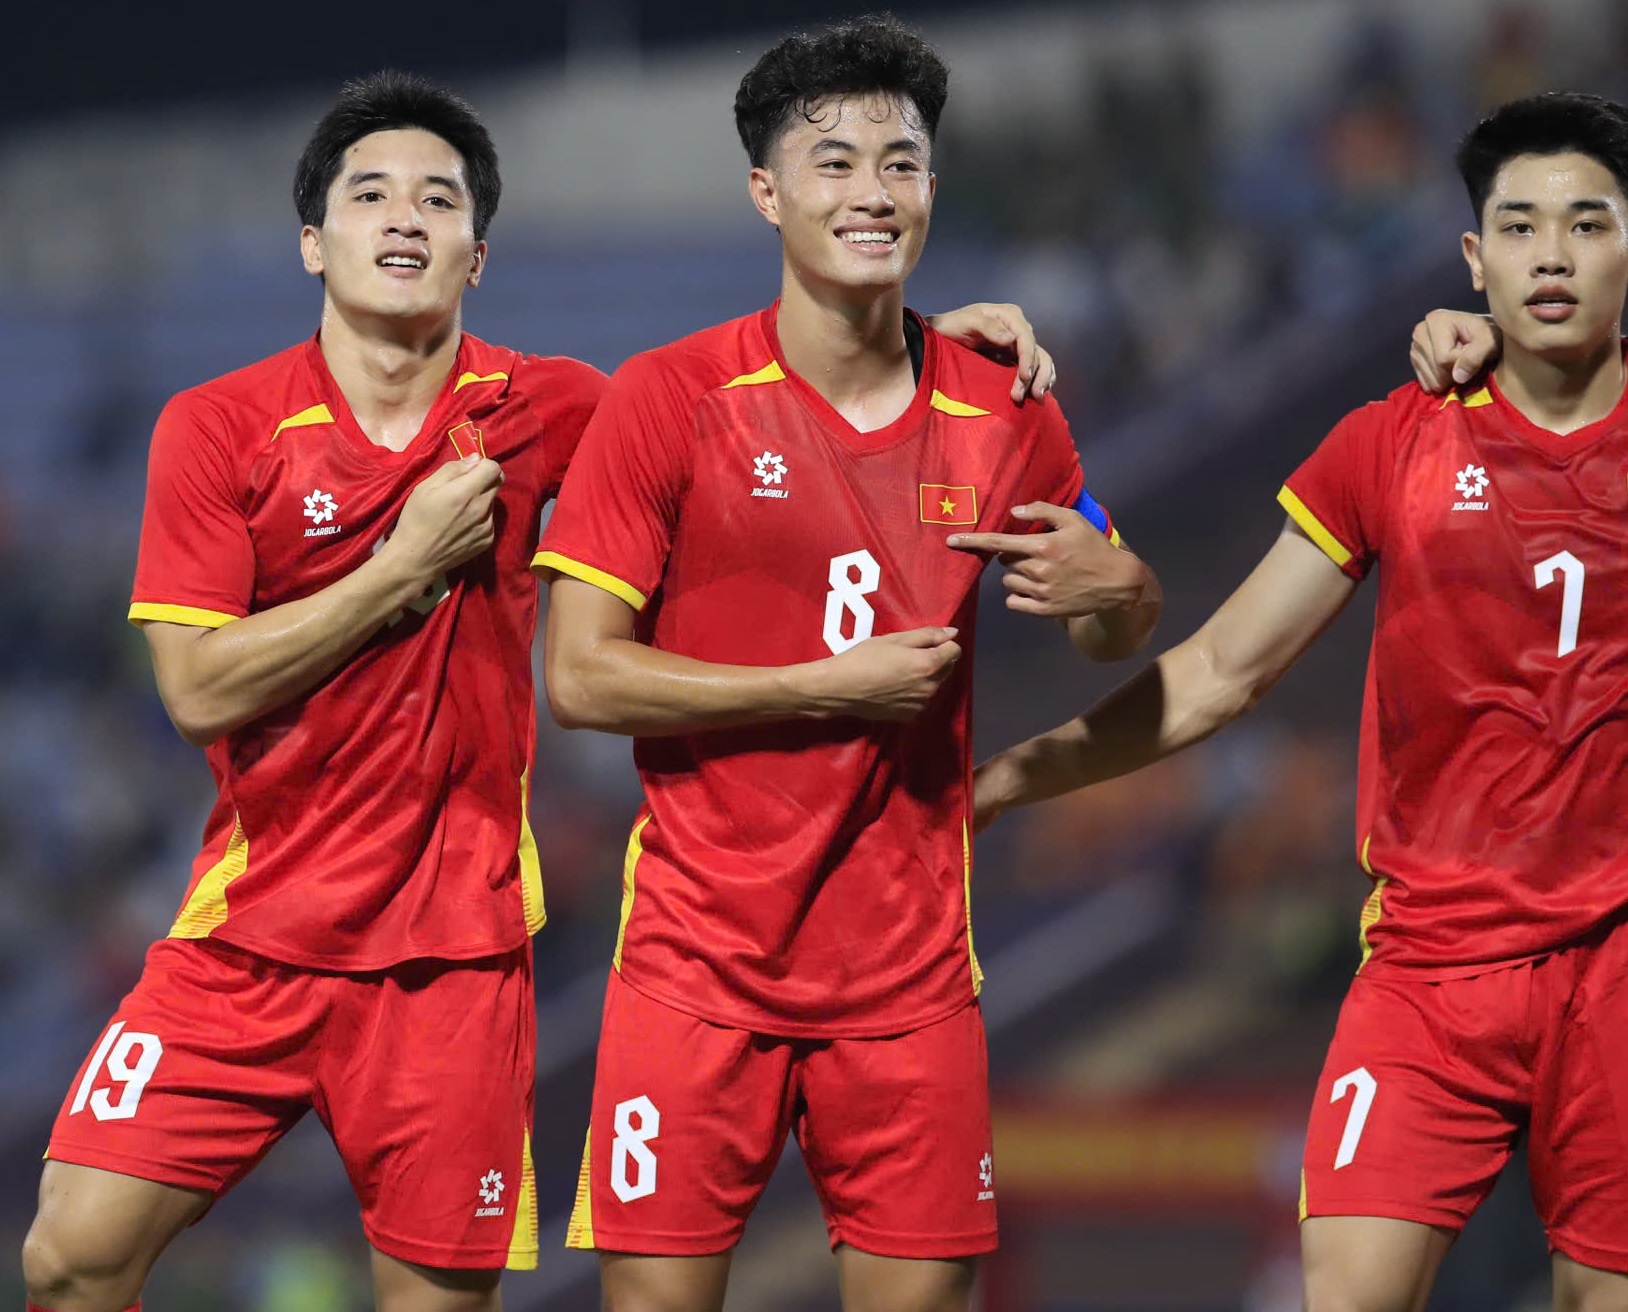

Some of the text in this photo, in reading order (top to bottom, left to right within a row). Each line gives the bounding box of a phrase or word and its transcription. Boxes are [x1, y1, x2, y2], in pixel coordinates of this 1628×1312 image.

[303, 525, 342, 537] JOGARBOLA
[751, 487, 788, 499] JOGARBOLA
[822, 549, 881, 656] 8
[1533, 550, 1585, 658] 7
[69, 1020, 163, 1121] 19
[1330, 1066, 1378, 1171] 7
[610, 1094, 660, 1204] 8
